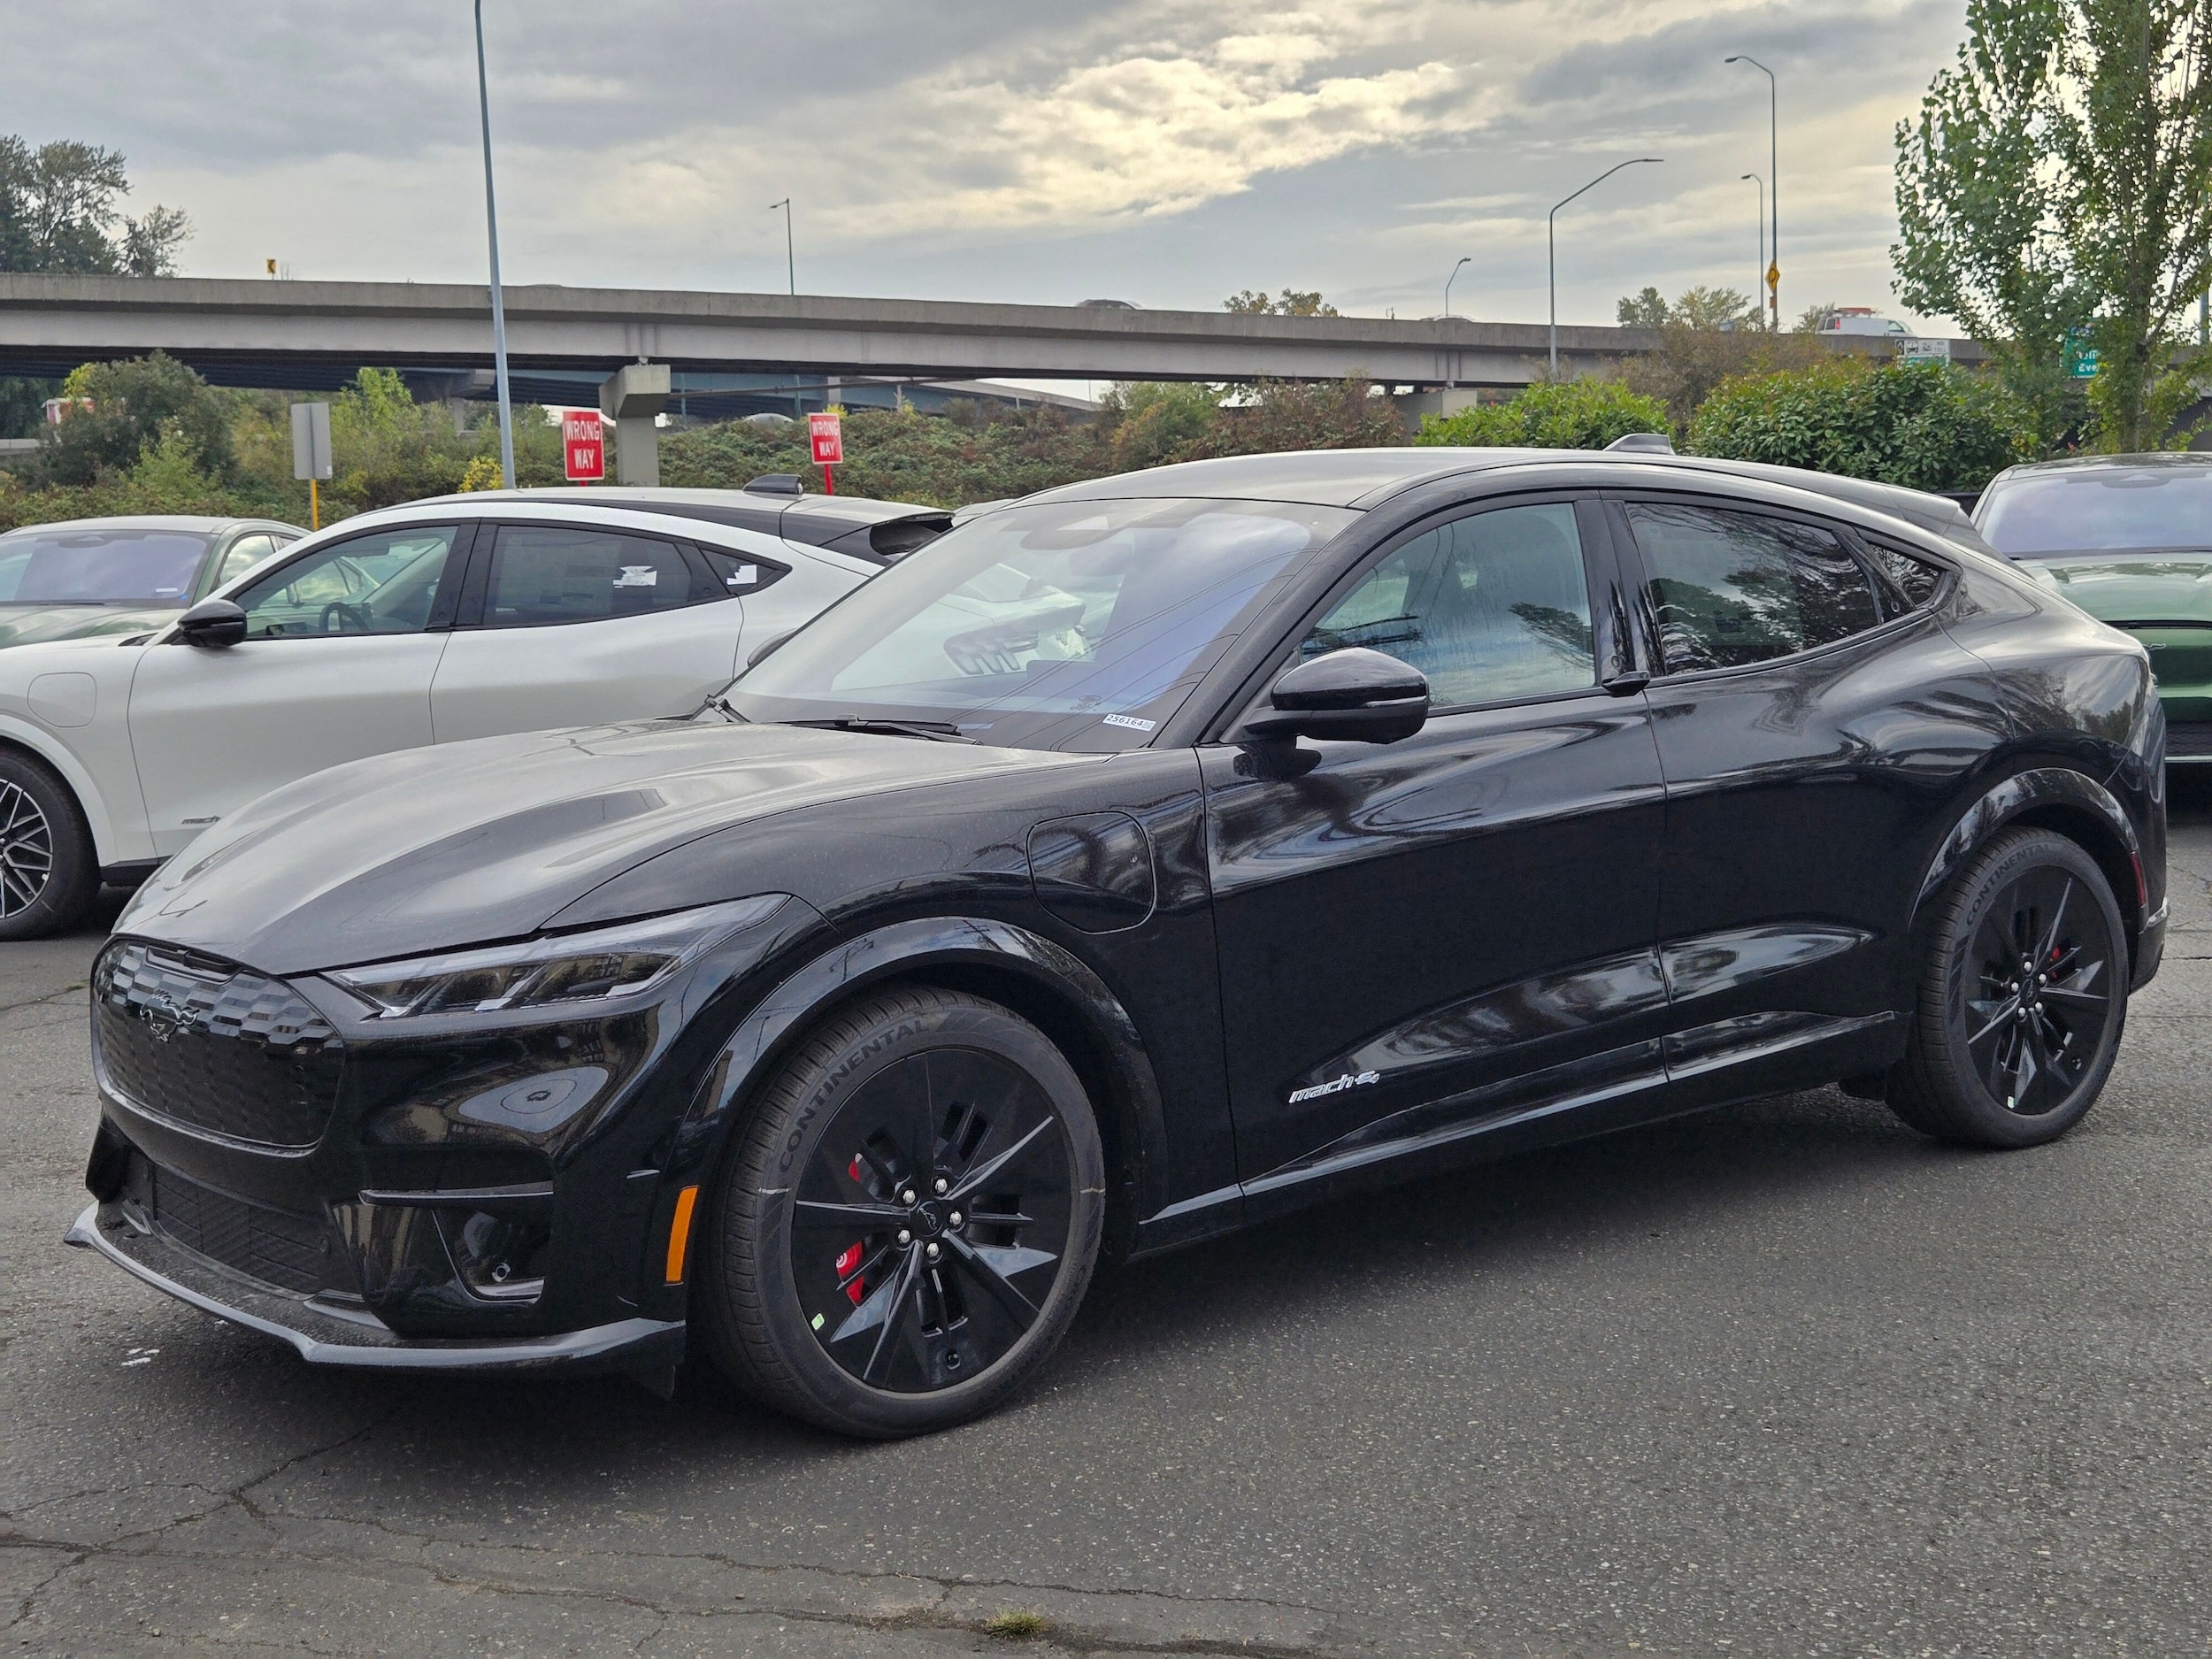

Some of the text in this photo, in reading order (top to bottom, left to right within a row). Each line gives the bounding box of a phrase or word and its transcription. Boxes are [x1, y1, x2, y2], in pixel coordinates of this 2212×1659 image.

[565, 420, 600, 441] WRONG
[811, 421, 839, 436] WRONG
[573, 449, 595, 469] WAY
[818, 442, 835, 457] WAY
[1106, 714, 1144, 726] 256164
[1966, 844, 2052, 926] CONTINENTAL
[779, 1019, 929, 1172] CONTINENTAL
